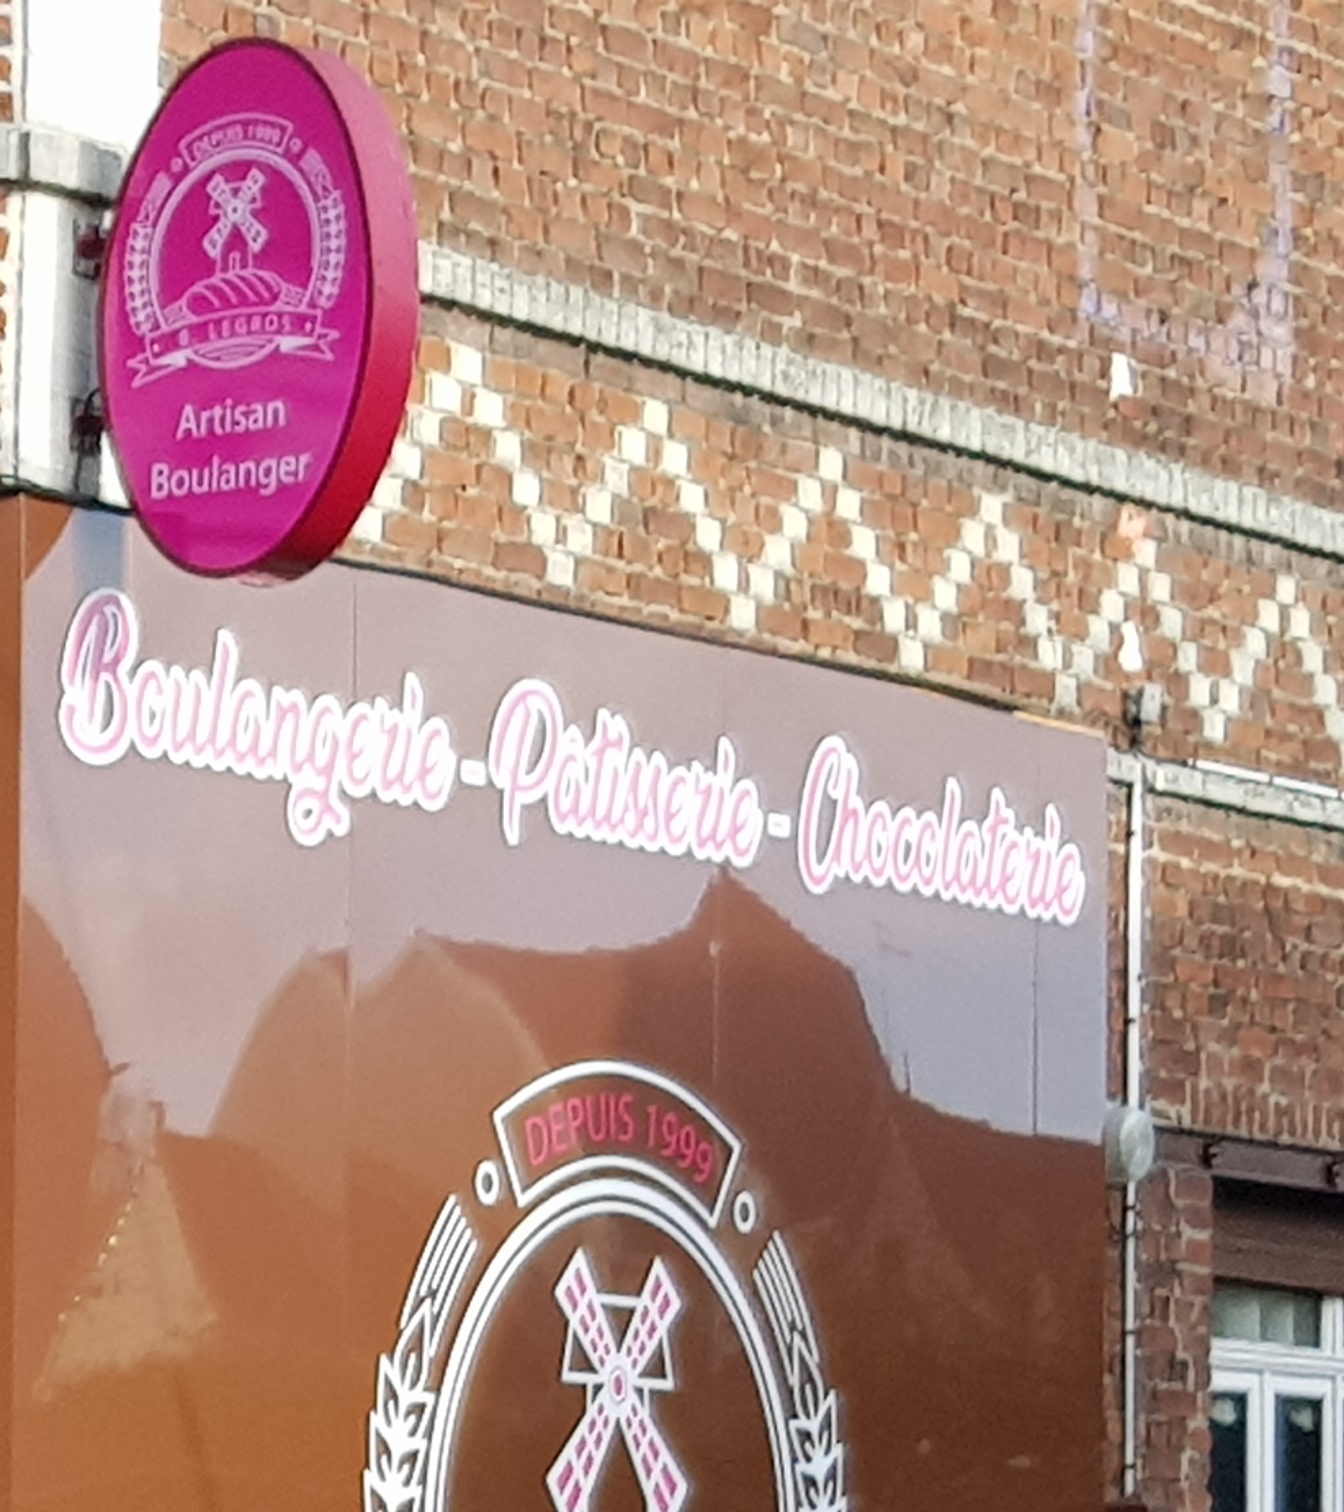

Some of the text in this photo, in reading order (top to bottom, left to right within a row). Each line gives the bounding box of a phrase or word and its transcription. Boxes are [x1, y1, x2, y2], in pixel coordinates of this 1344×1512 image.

[207, 313, 291, 339] LEGROS
[176, 398, 287, 441] Artisan
[149, 450, 312, 498] Boulanger
[58, 587, 457, 847] Boulangerie
[488, 678, 764, 869] Pâtisserie
[797, 735, 1086, 927] Chocolaterie
[524, 1094, 716, 1184] DEPUIS 1999
